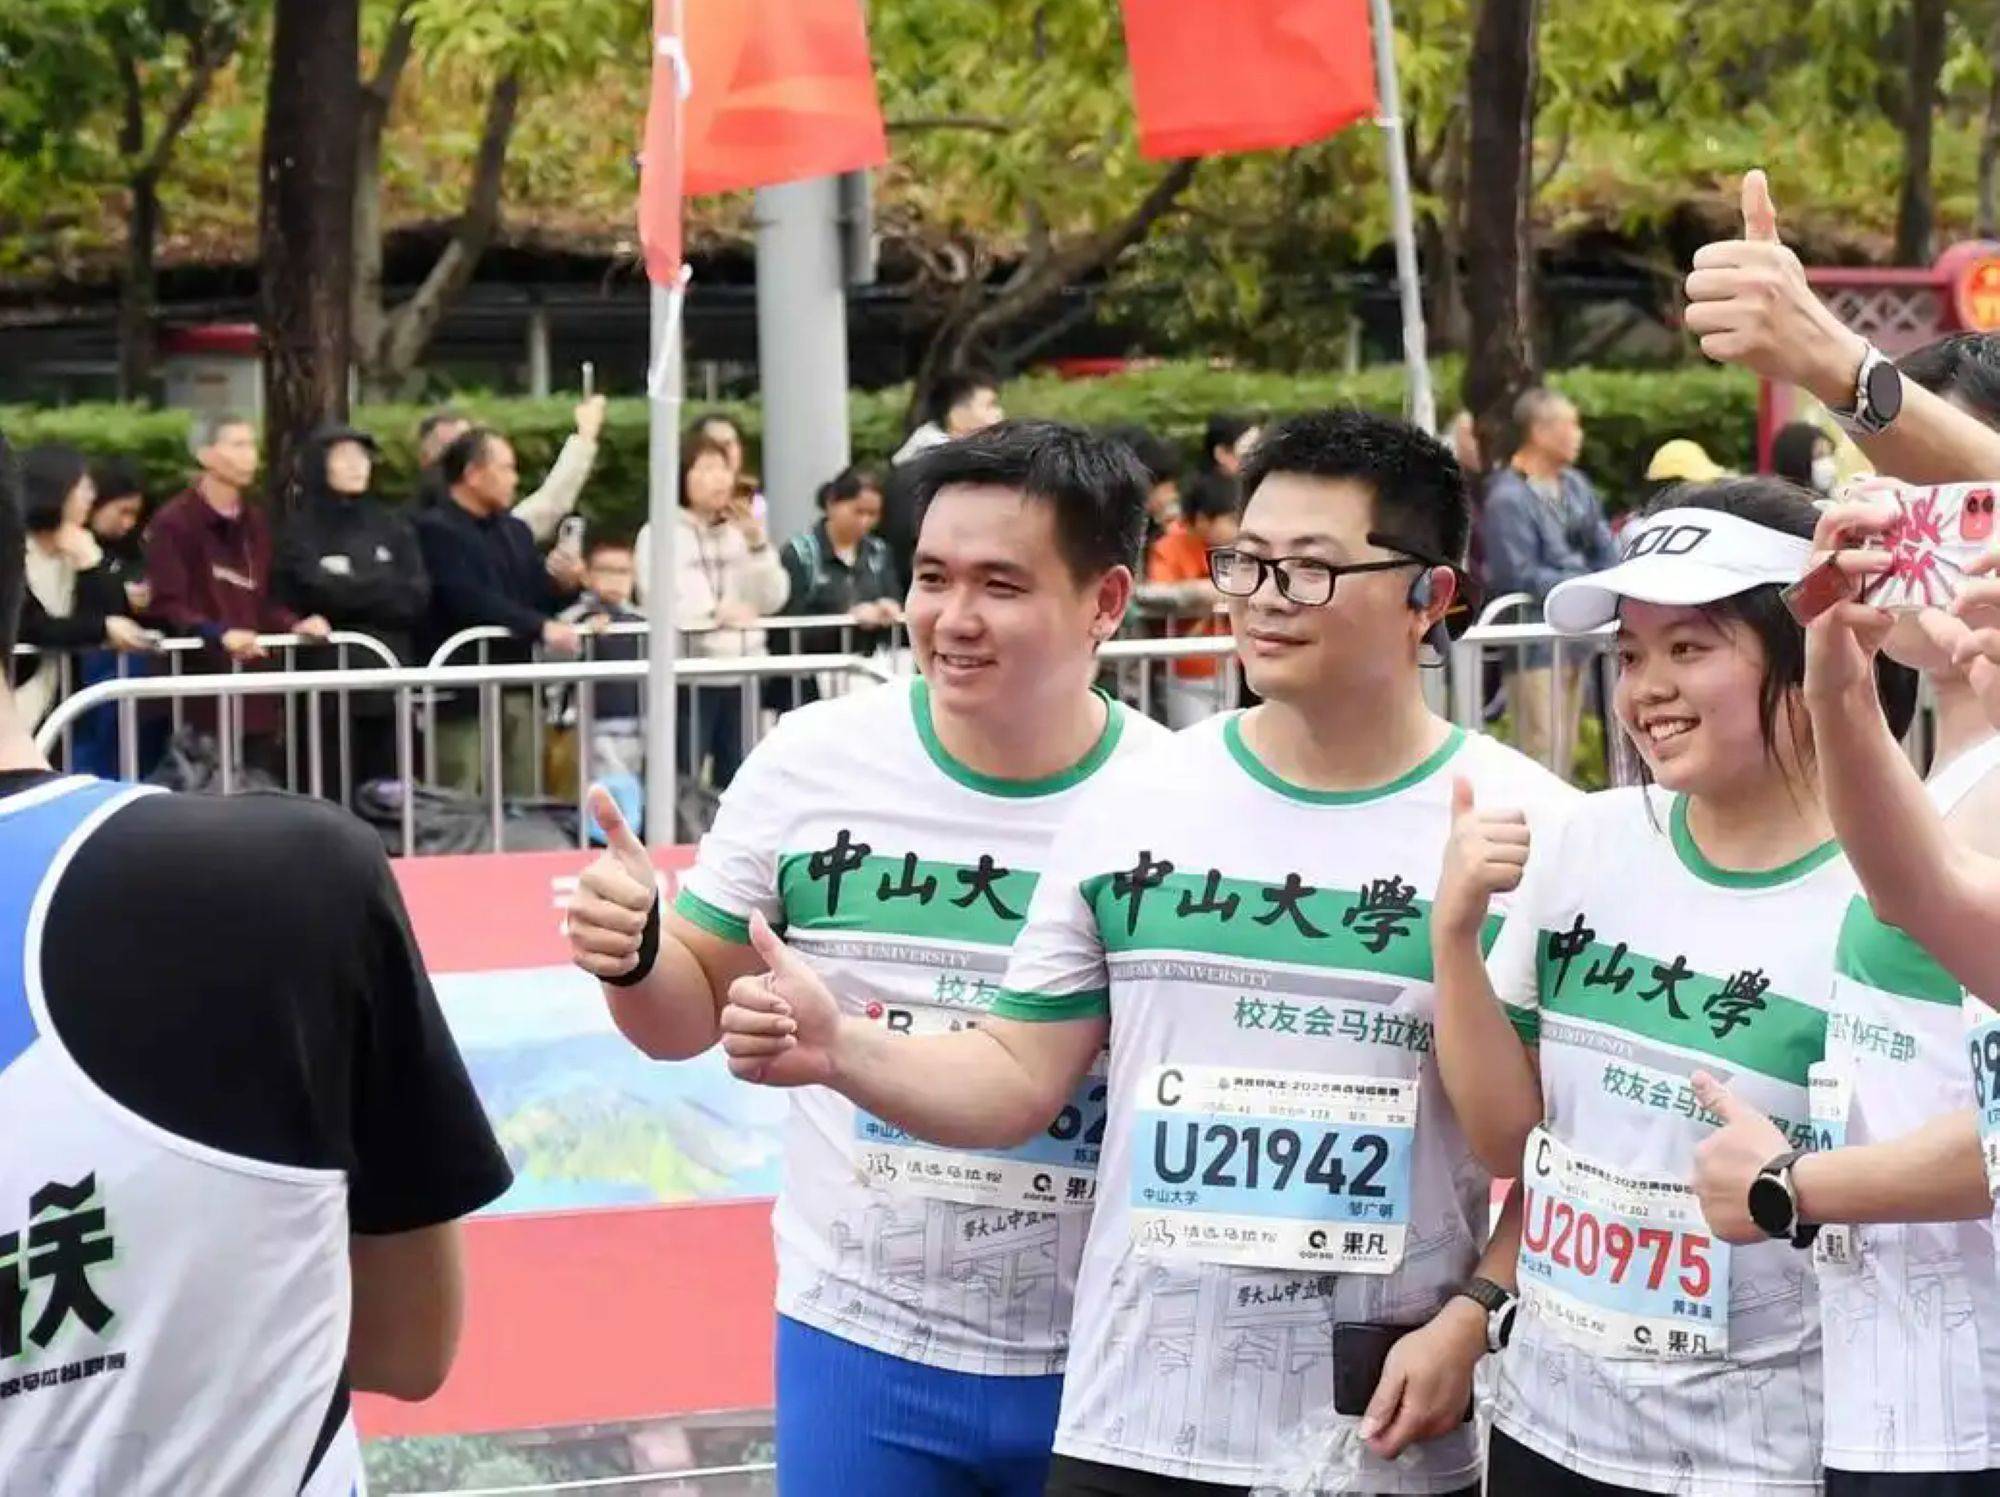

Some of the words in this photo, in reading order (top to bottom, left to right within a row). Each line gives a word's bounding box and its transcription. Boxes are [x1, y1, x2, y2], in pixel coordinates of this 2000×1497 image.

[1165, 962, 1274, 988] UNIVERSITY
[1157, 1069, 1184, 1107] C
[1154, 1120, 1390, 1198] U21942
[1535, 1137, 1551, 1177] C
[1524, 1187, 1711, 1299] U20975
